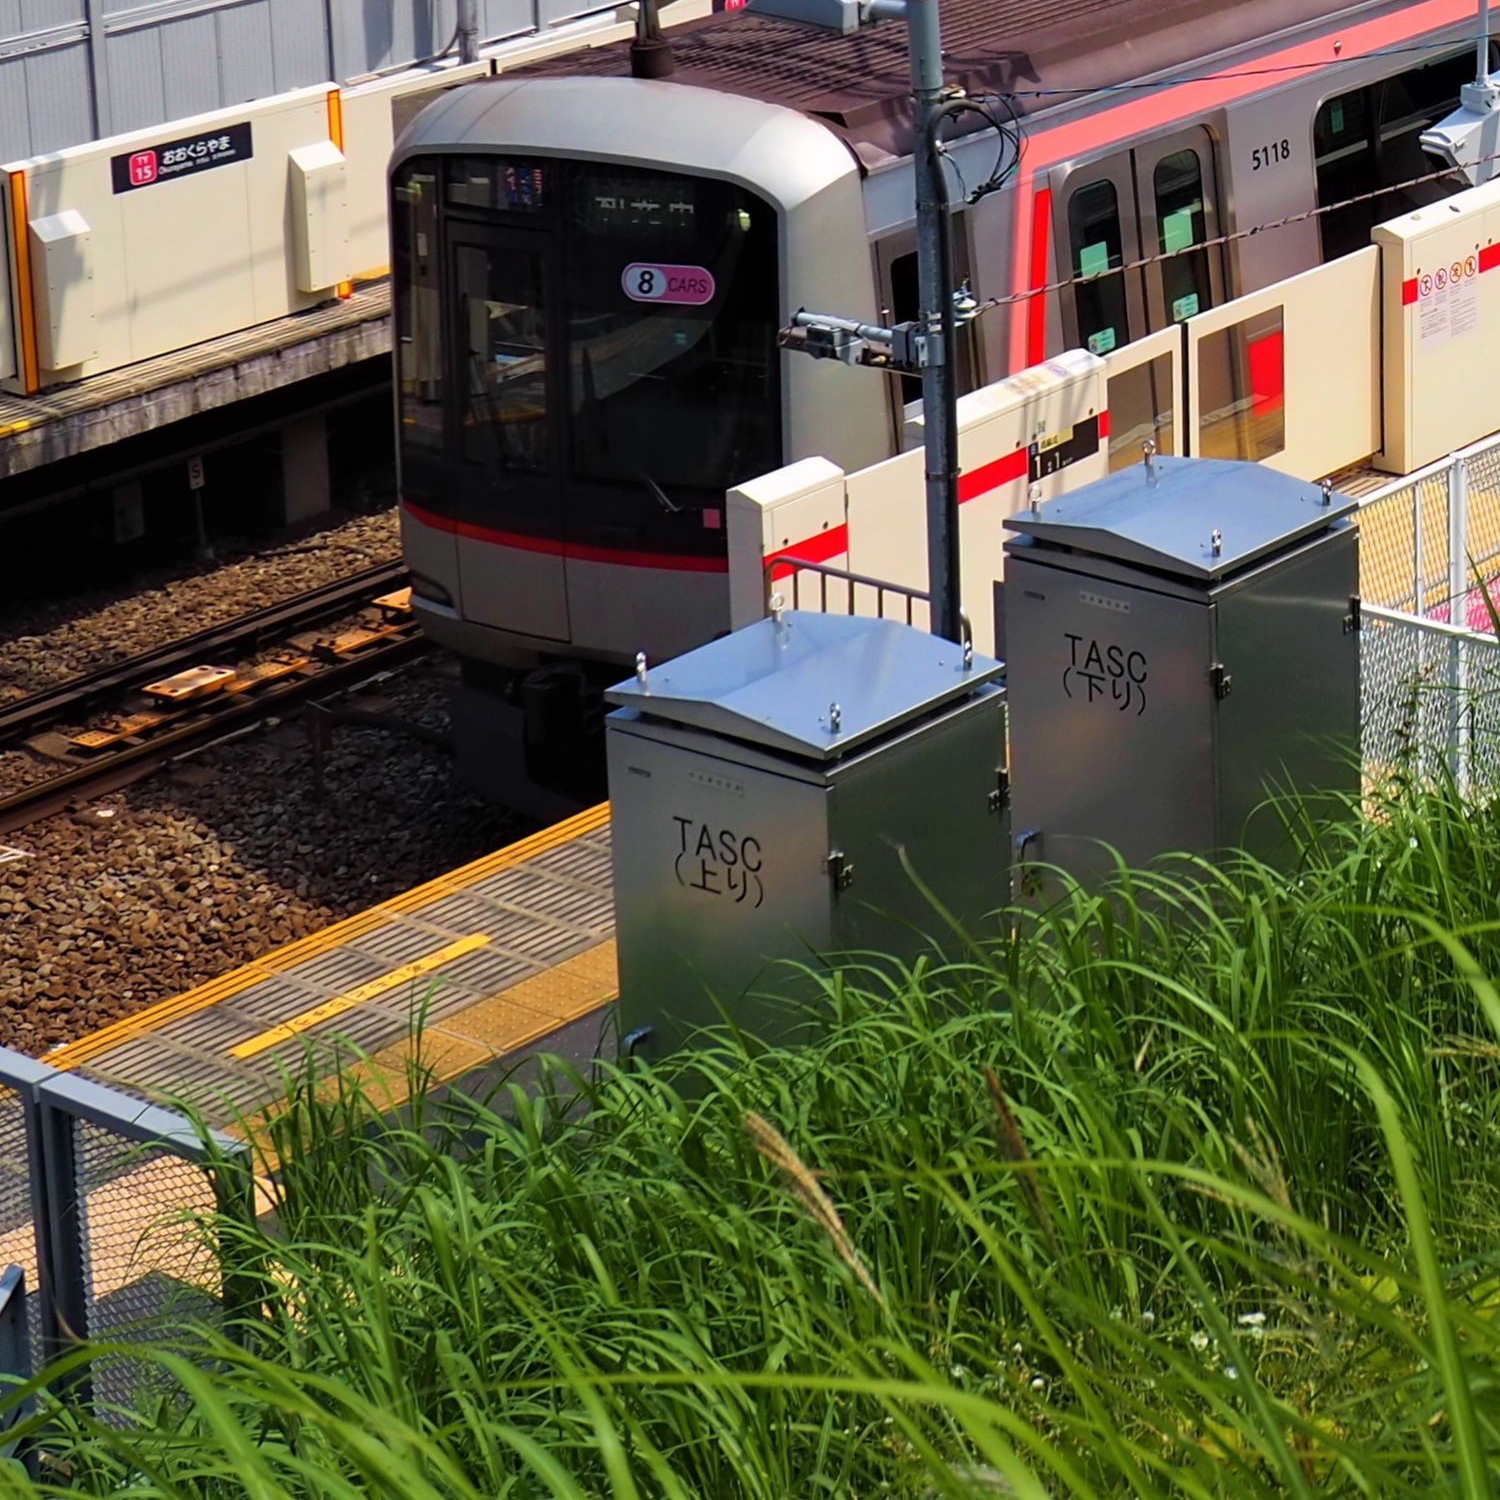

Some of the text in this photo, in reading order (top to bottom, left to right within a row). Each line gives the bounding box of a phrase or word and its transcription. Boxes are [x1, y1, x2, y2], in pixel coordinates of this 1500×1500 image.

[136, 155, 150, 166] TY
[163, 136, 231, 165] おおくらやま
[1252, 139, 1290, 171] 5118
[135, 165, 153, 181] 15
[638, 269, 707, 295] 8 CARS
[1064, 632, 1147, 684] TASC
[1062, 667, 1147, 716] (下り)
[672, 815, 763, 873] TASC
[674, 852, 764, 909] (上り)
